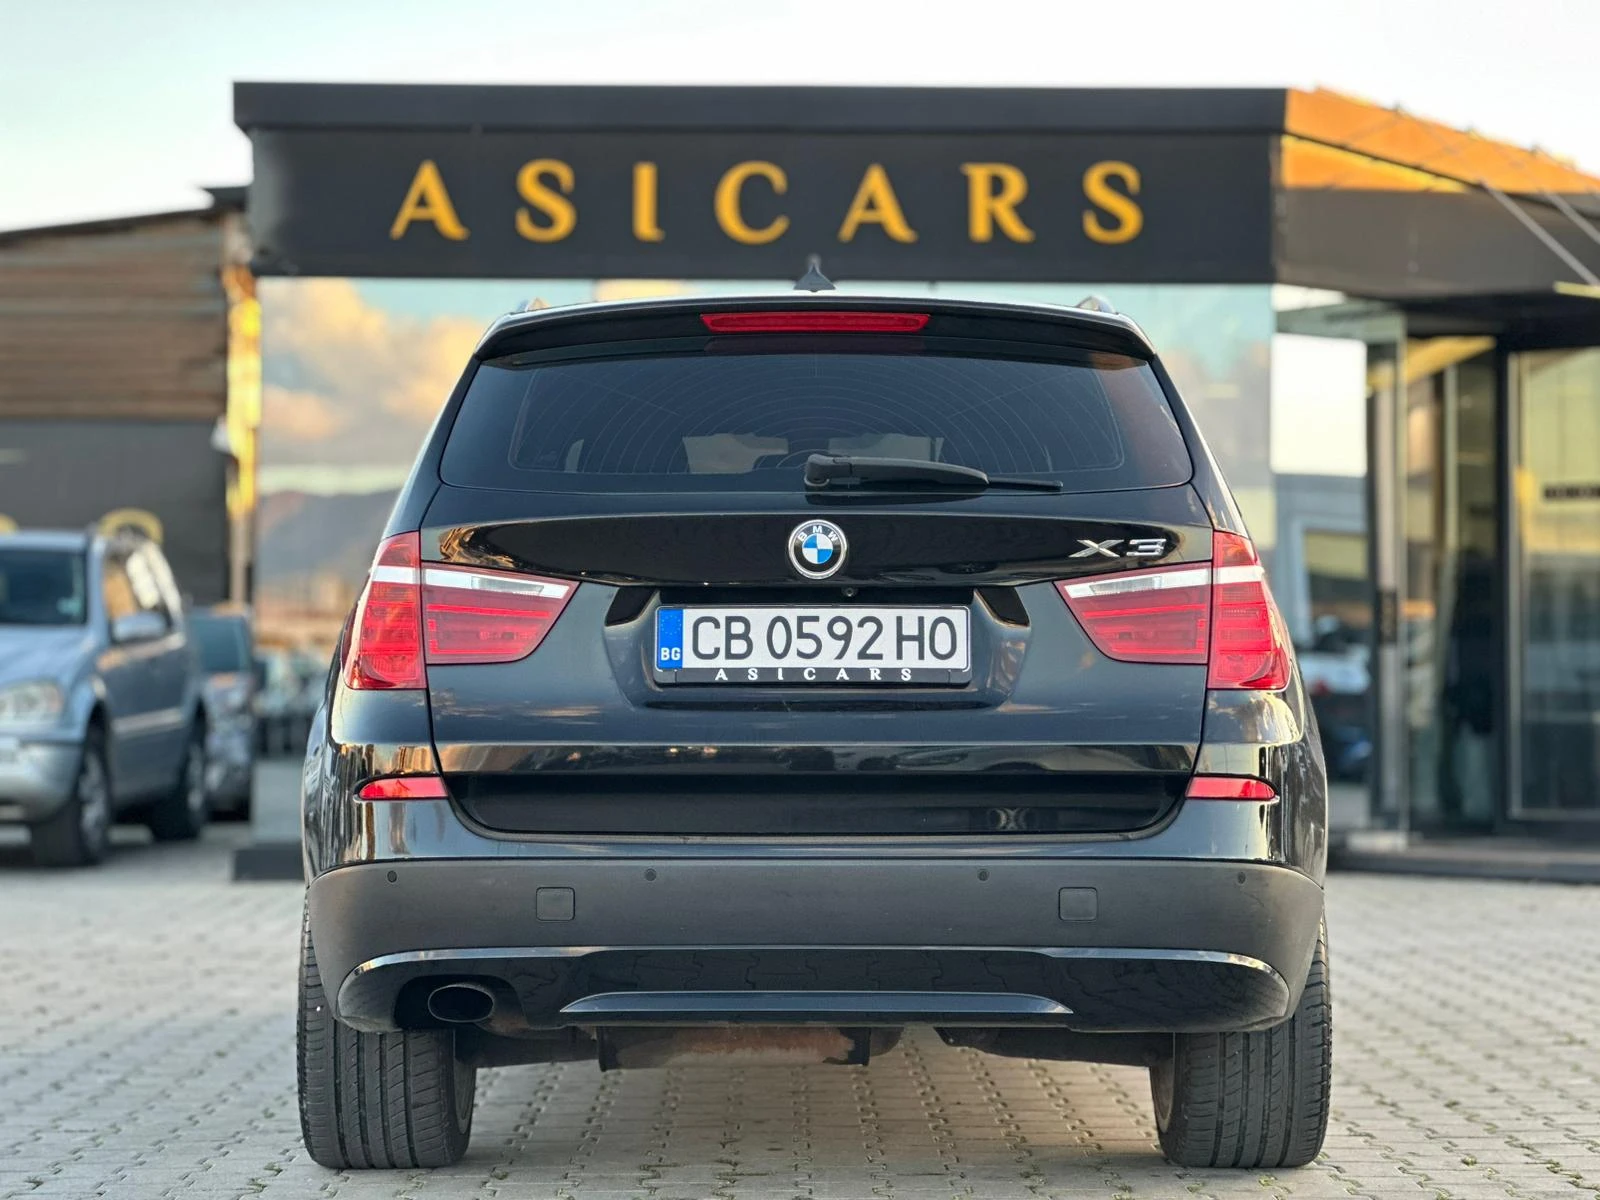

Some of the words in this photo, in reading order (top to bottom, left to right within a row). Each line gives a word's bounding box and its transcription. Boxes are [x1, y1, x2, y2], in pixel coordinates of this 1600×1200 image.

[391, 159, 1144, 244] ASICARS
[797, 525, 838, 542] BMW
[1068, 537, 1168, 559] X3
[692, 615, 754, 661] CB
[766, 615, 884, 661] 0592
[660, 646, 681, 661] BG
[714, 667, 913, 682] ASICARS
